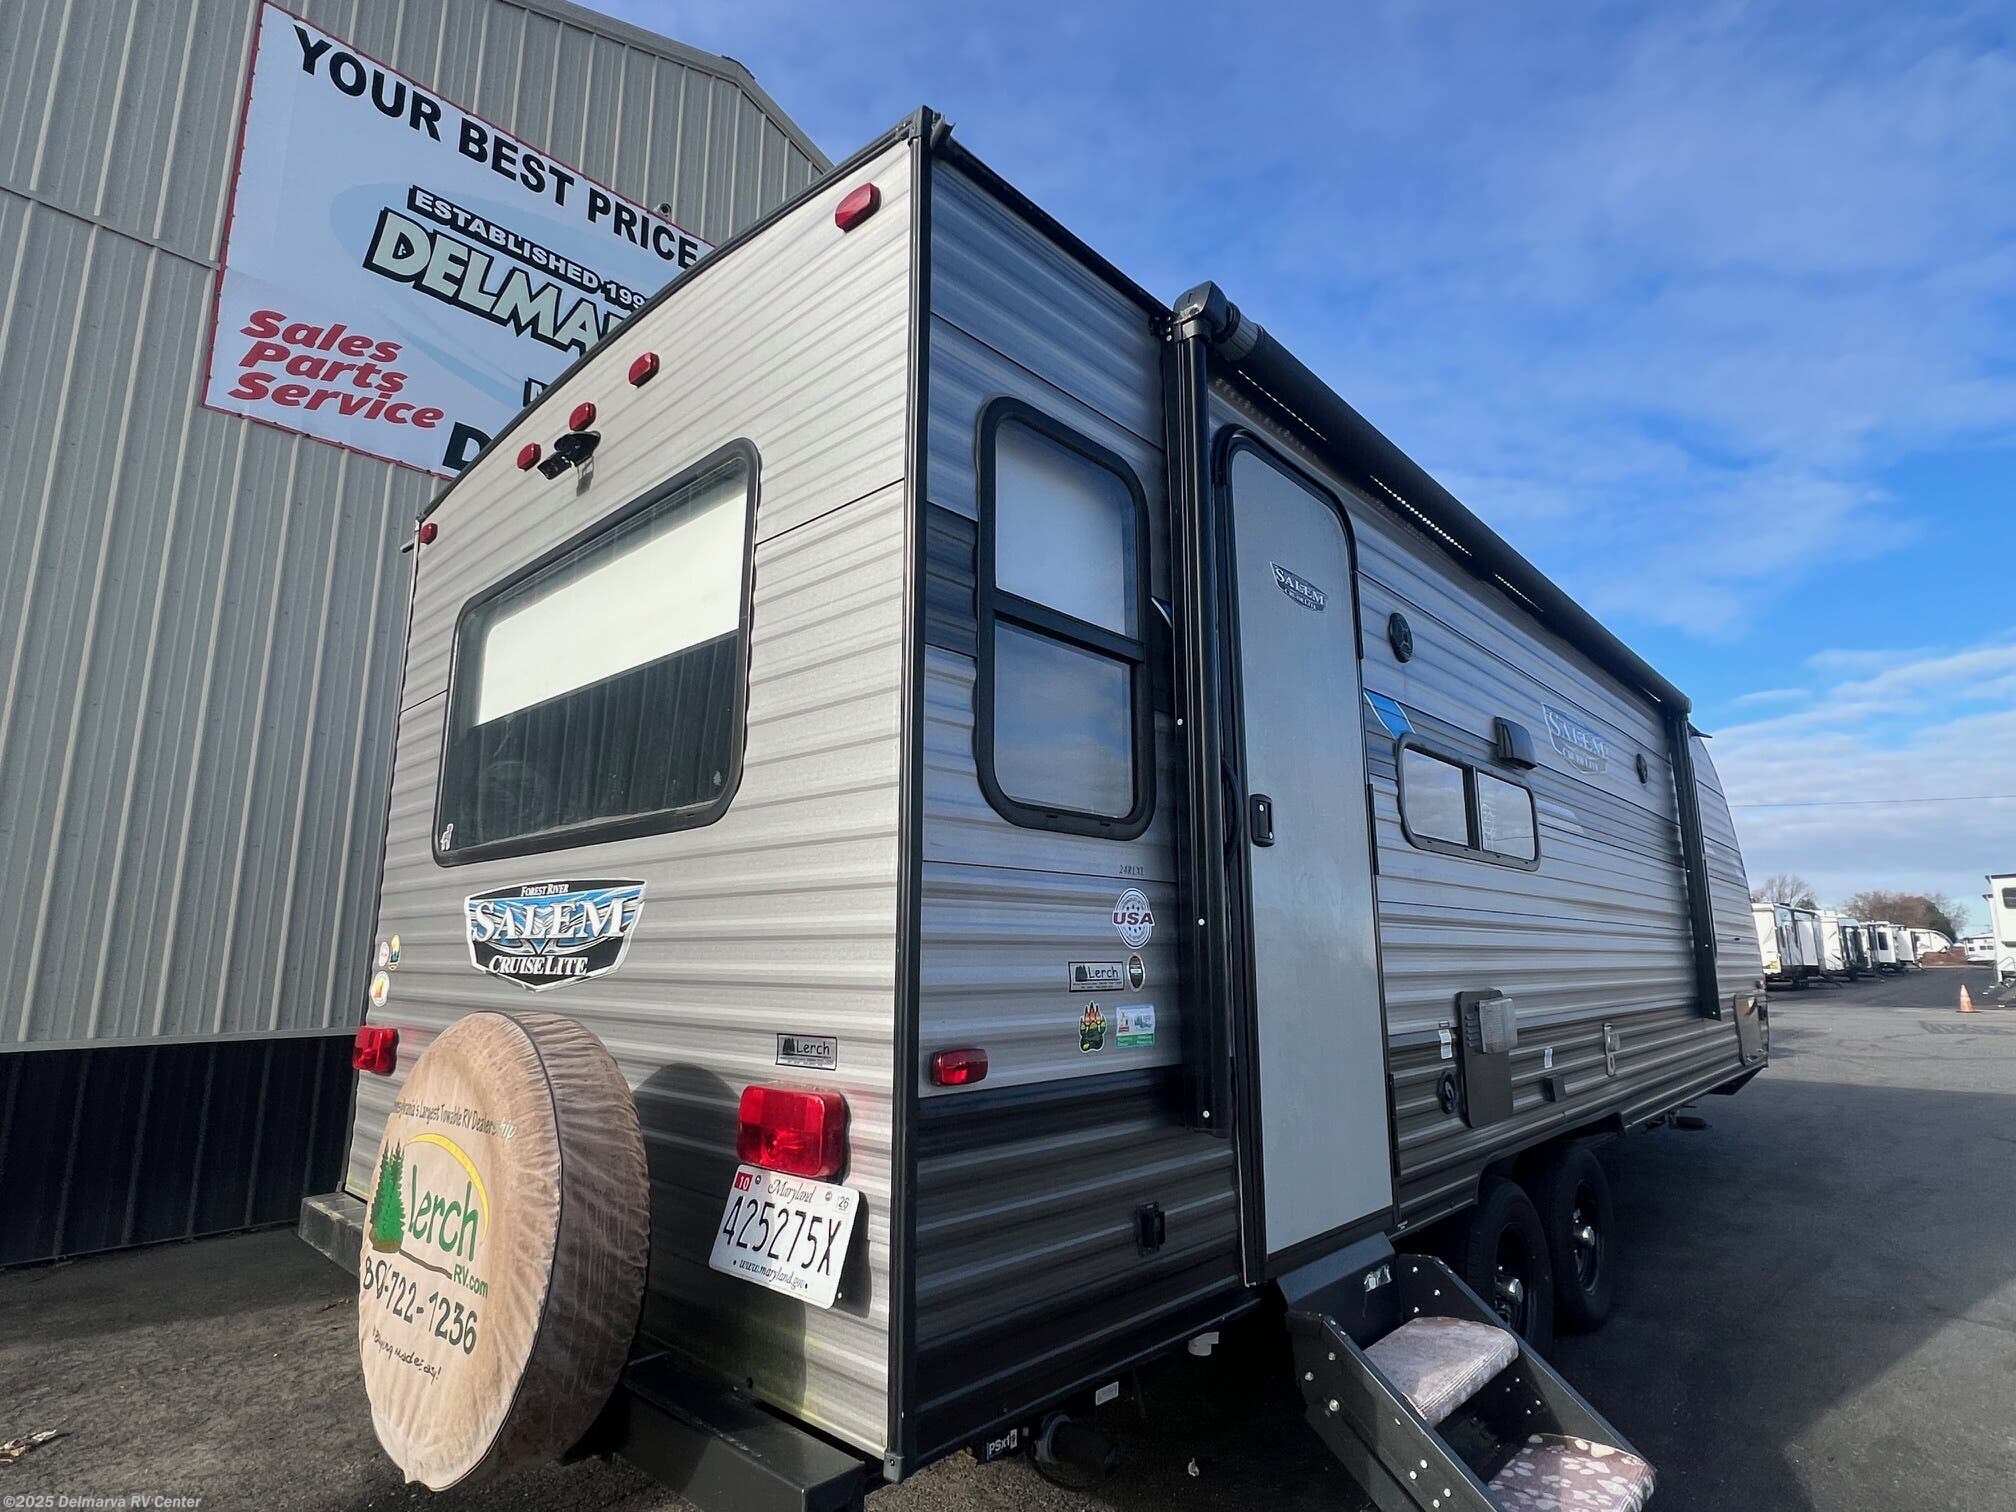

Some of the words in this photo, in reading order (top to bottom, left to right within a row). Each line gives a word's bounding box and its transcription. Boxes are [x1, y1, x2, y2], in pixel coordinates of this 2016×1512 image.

[293, 24, 441, 142] YOUR
[458, 117, 575, 206] BEST
[587, 187, 700, 271] PRICE
[412, 187, 600, 292] ESTABLISHED
[240, 310, 403, 363] Sales
[239, 341, 409, 393] Parts
[228, 372, 444, 428] Service
[1275, 568, 1325, 605] SALEM
[520, 884, 547, 897] FOREST
[548, 883, 570, 896] RIVER
[473, 897, 627, 942] SALEM
[1113, 911, 1154, 926] USA
[1088, 965, 1119, 979] Lerch
[796, 1039, 830, 1055] Lerch
[738, 1175, 750, 1191] 10
[767, 1178, 817, 1204] Maryland
[722, 1195, 842, 1276] 425275X
[453, 1263, 488, 1300] RV.com
